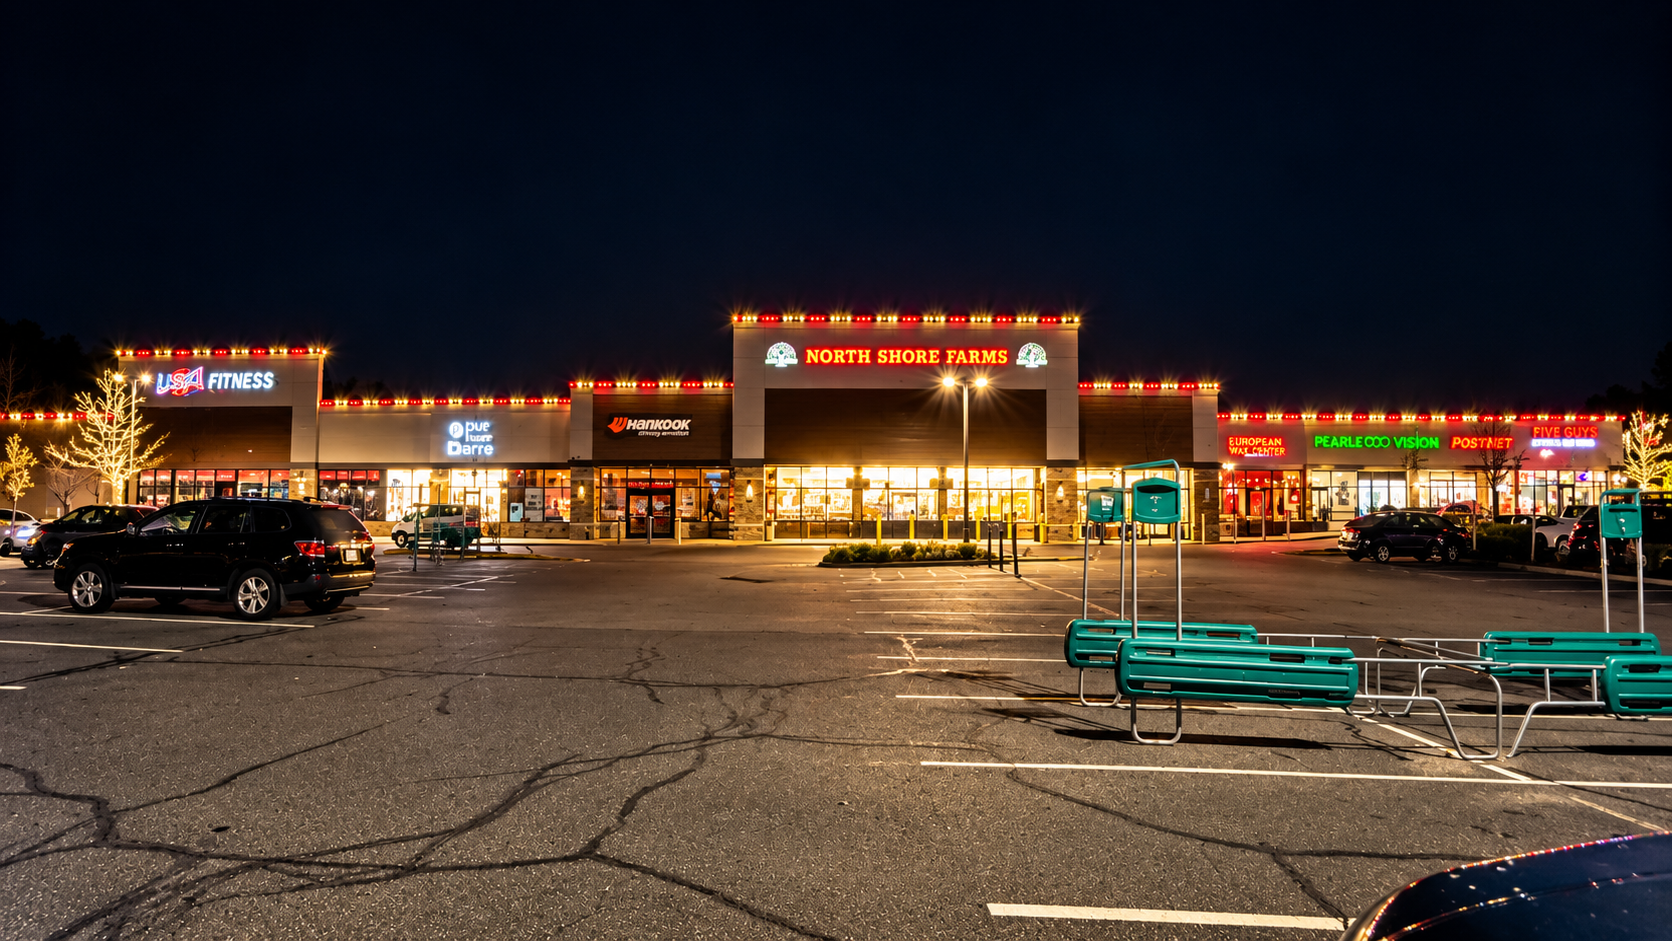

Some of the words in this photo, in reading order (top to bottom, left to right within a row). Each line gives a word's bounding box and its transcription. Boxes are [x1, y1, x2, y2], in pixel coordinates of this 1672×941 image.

[805, 348, 872, 365] NORTH
[877, 348, 940, 365] SHORE
[945, 348, 1008, 365] FARMS
[156, 366, 205, 396] USA
[208, 371, 275, 391] FITNESS
[1533, 426, 1561, 438] FIVE
[1564, 426, 1598, 438] GUYS
[1229, 437, 1282, 446] EUROPEAN
[1314, 436, 1364, 449] PEARLE
[1393, 437, 1440, 449] VISION
